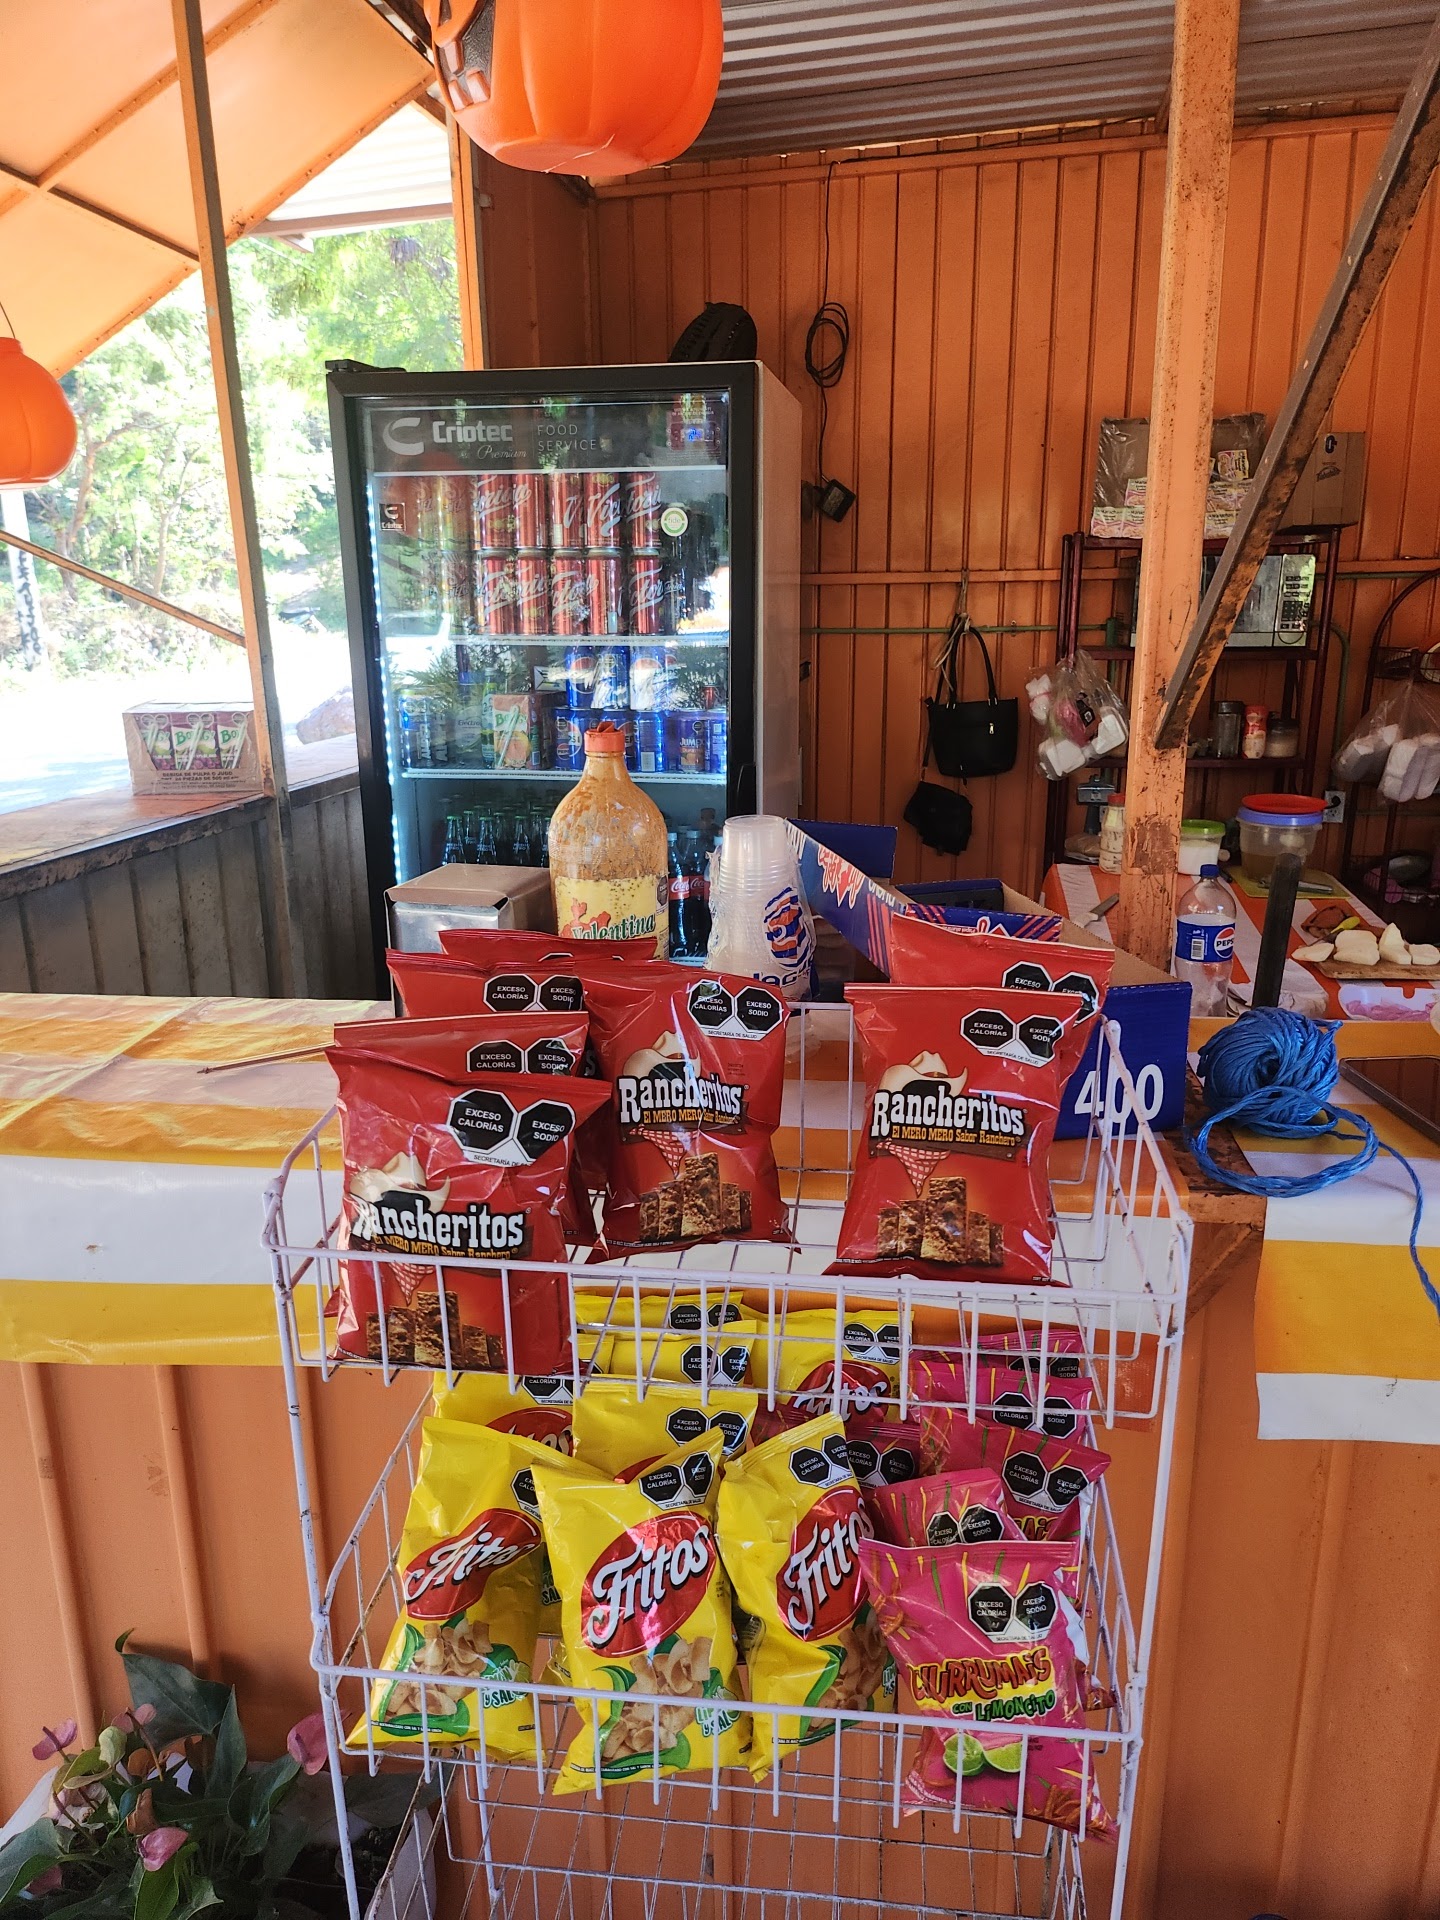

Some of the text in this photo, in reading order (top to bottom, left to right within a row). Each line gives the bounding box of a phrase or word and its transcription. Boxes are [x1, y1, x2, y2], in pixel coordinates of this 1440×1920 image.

[432, 420, 513, 443] Criotec
[537, 424, 578, 436] FOOD
[477, 444, 527, 460] Premium
[538, 440, 597, 452] SERVICE
[571, 913, 656, 940] Valentina
[1015, 977, 1041, 988] EXCESO
[694, 1003, 727, 1012] CALORÍAS
[746, 1001, 772, 1009] EXCESO
[748, 1009, 769, 1017] SODIO
[974, 1022, 1004, 1030] EXCESO
[969, 1029, 1007, 1037] CALORÍAS
[1032, 1034, 1051, 1042] SODI
[538, 1054, 566, 1062] EXCESO
[618, 1066, 742, 1124] Rancheritos
[1074, 1063, 1164, 1123] 400
[465, 1107, 502, 1121] EXCESO
[652, 1110, 677, 1123] MERO
[678, 1109, 701, 1122] MERO
[871, 1085, 1025, 1137] Rancheritos
[458, 1117, 504, 1133] CALORÍAS
[531, 1120, 565, 1133] EXCESO
[533, 1131, 559, 1142] SODIO
[892, 1126, 1016, 1146] El MERO MERO Sabor Ranchero
[352, 1199, 524, 1248] Rancheritos
[385, 1235, 409, 1251] MERO
[411, 1241, 439, 1255] MERO
[999, 1412, 1029, 1420] CALORÍAS
[718, 1422, 741, 1430] EXCESO
[848, 1449, 871, 1460] EXCESO
[798, 1457, 819, 1469] EXCESO
[848, 1456, 873, 1467] ALORÍAS
[801, 1461, 826, 1476] CALORÍAS
[1013, 1464, 1038, 1477] EXCESO
[648, 1472, 673, 1481] EXCESO
[1009, 1470, 1039, 1485] CALORÍAS
[646, 1479, 677, 1489] CALORÍAS
[1056, 1479, 1081, 1489] EXCESO
[967, 1519, 991, 1529] EXCESO
[972, 1527, 992, 1537] SODIO
[404, 1520, 535, 1601] Fritos
[783, 1497, 875, 1632] Fritos
[587, 1525, 709, 1645] Fritos
[1022, 1595, 1046, 1606] EXCESO
[976, 1608, 1007, 1616] CALORÍAS
[1025, 1604, 1047, 1614] SODIO
[491, 1690, 514, 1706] SAL
[952, 1702, 973, 1714] CON
